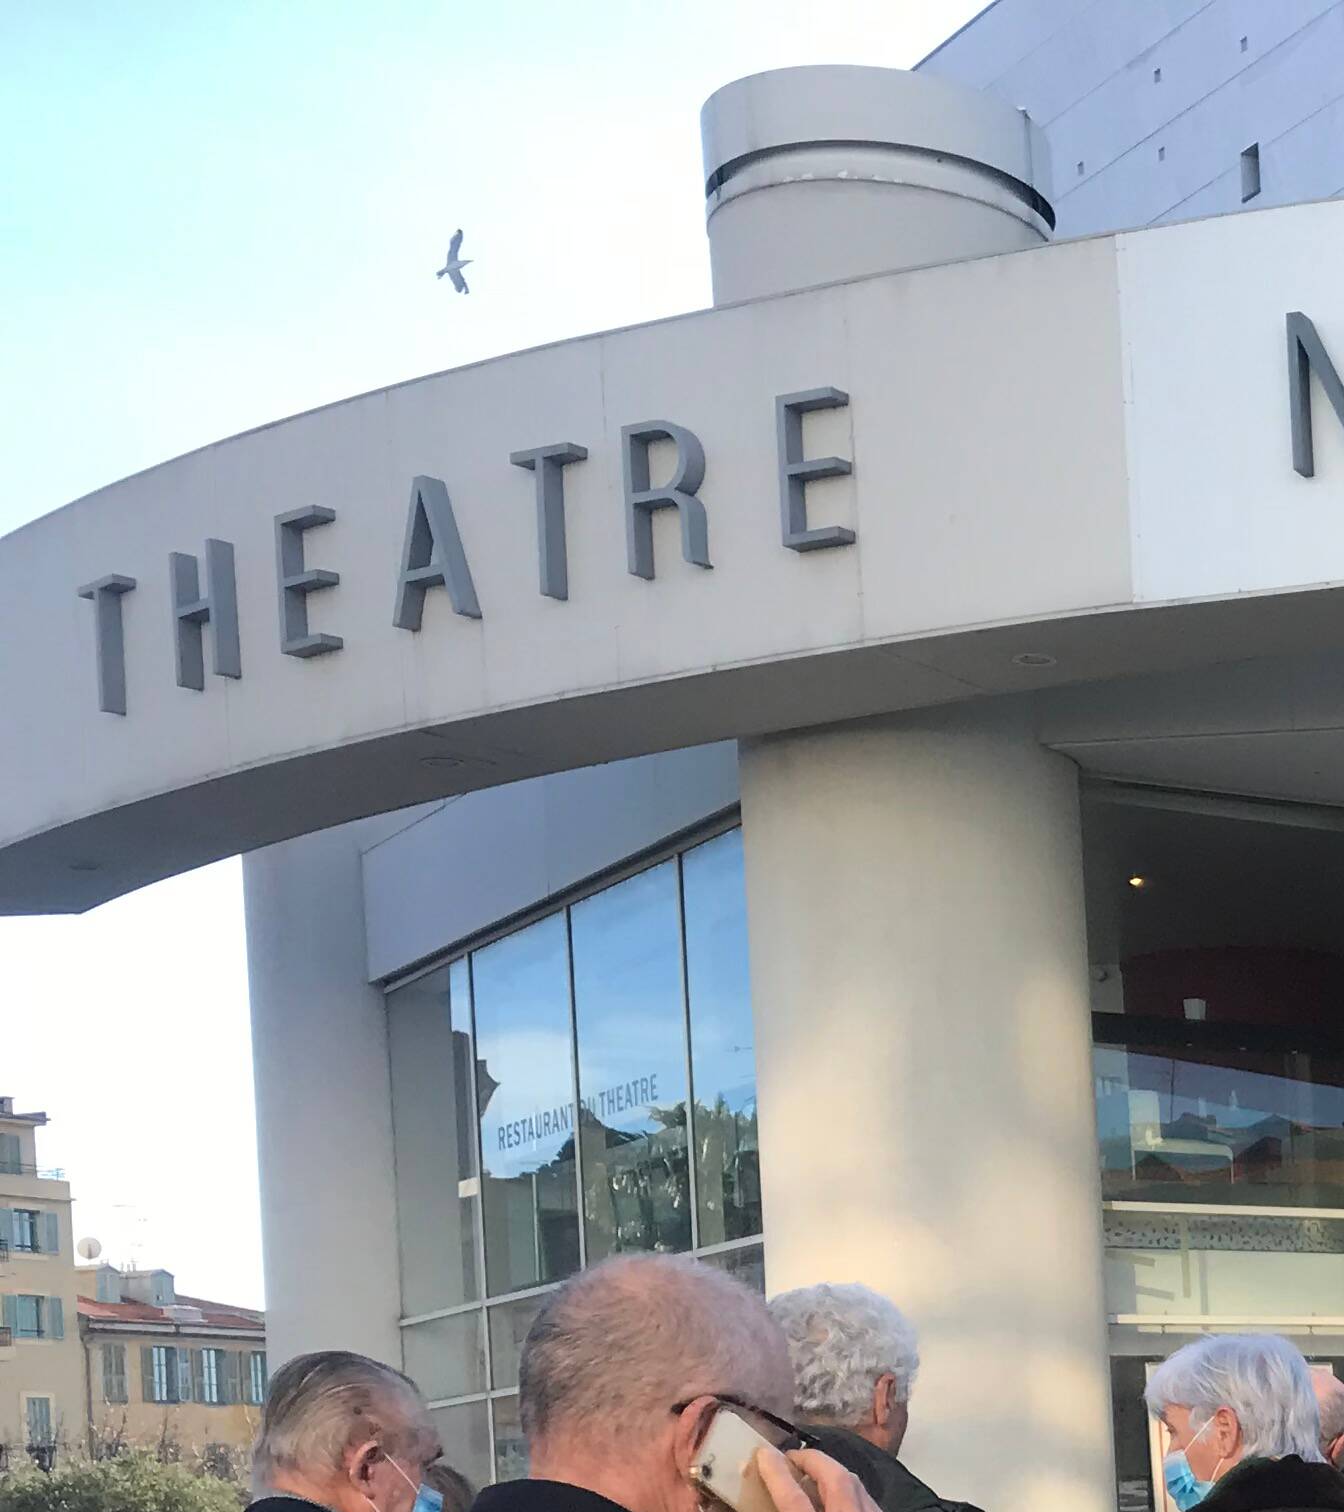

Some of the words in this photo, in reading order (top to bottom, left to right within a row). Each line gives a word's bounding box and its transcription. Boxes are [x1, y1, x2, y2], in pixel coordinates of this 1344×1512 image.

[78, 387, 856, 715] THEATRE
[498, 1102, 574, 1150] RESTAURANT
[598, 1074, 659, 1117] THEATRE
